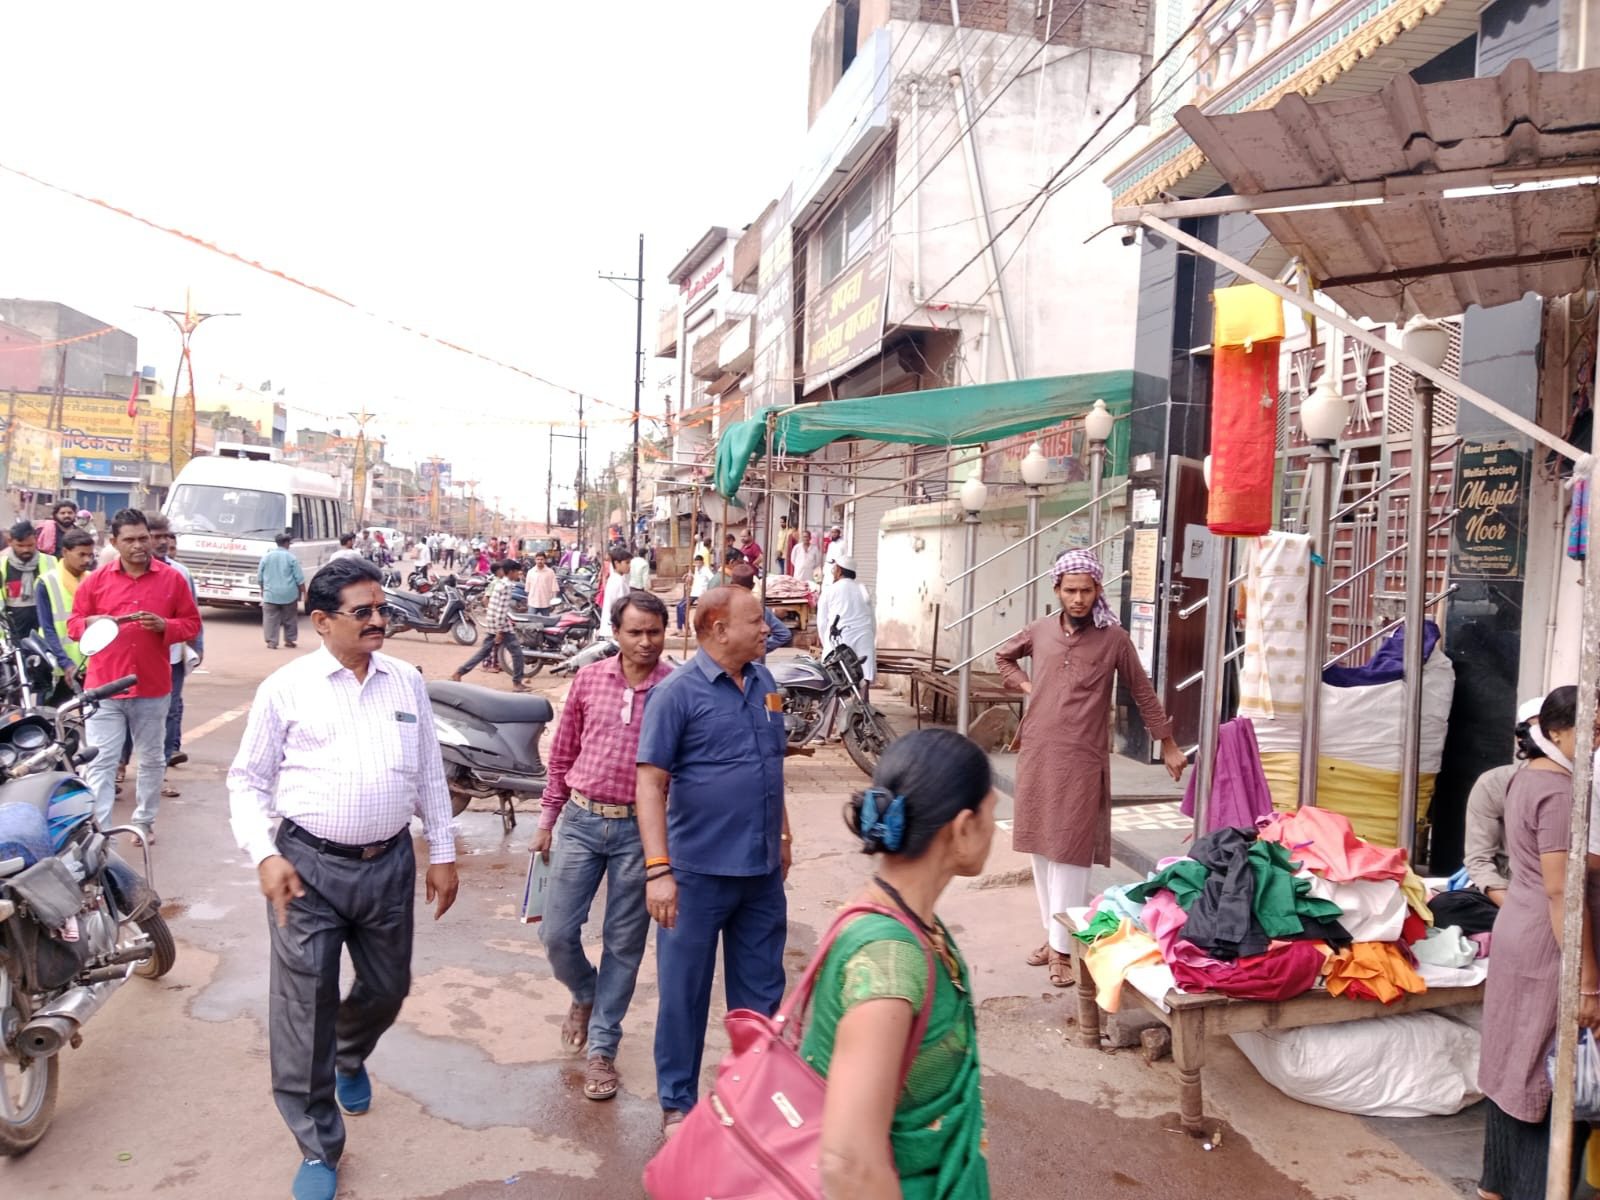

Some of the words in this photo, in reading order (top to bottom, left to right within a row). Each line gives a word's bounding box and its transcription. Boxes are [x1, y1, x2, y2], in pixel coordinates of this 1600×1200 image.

[1483, 454, 1498, 464] and
[1488, 465, 1517, 477] Society
[1459, 481, 1518, 514] Masjid
[1465, 515, 1506, 543] Noor
